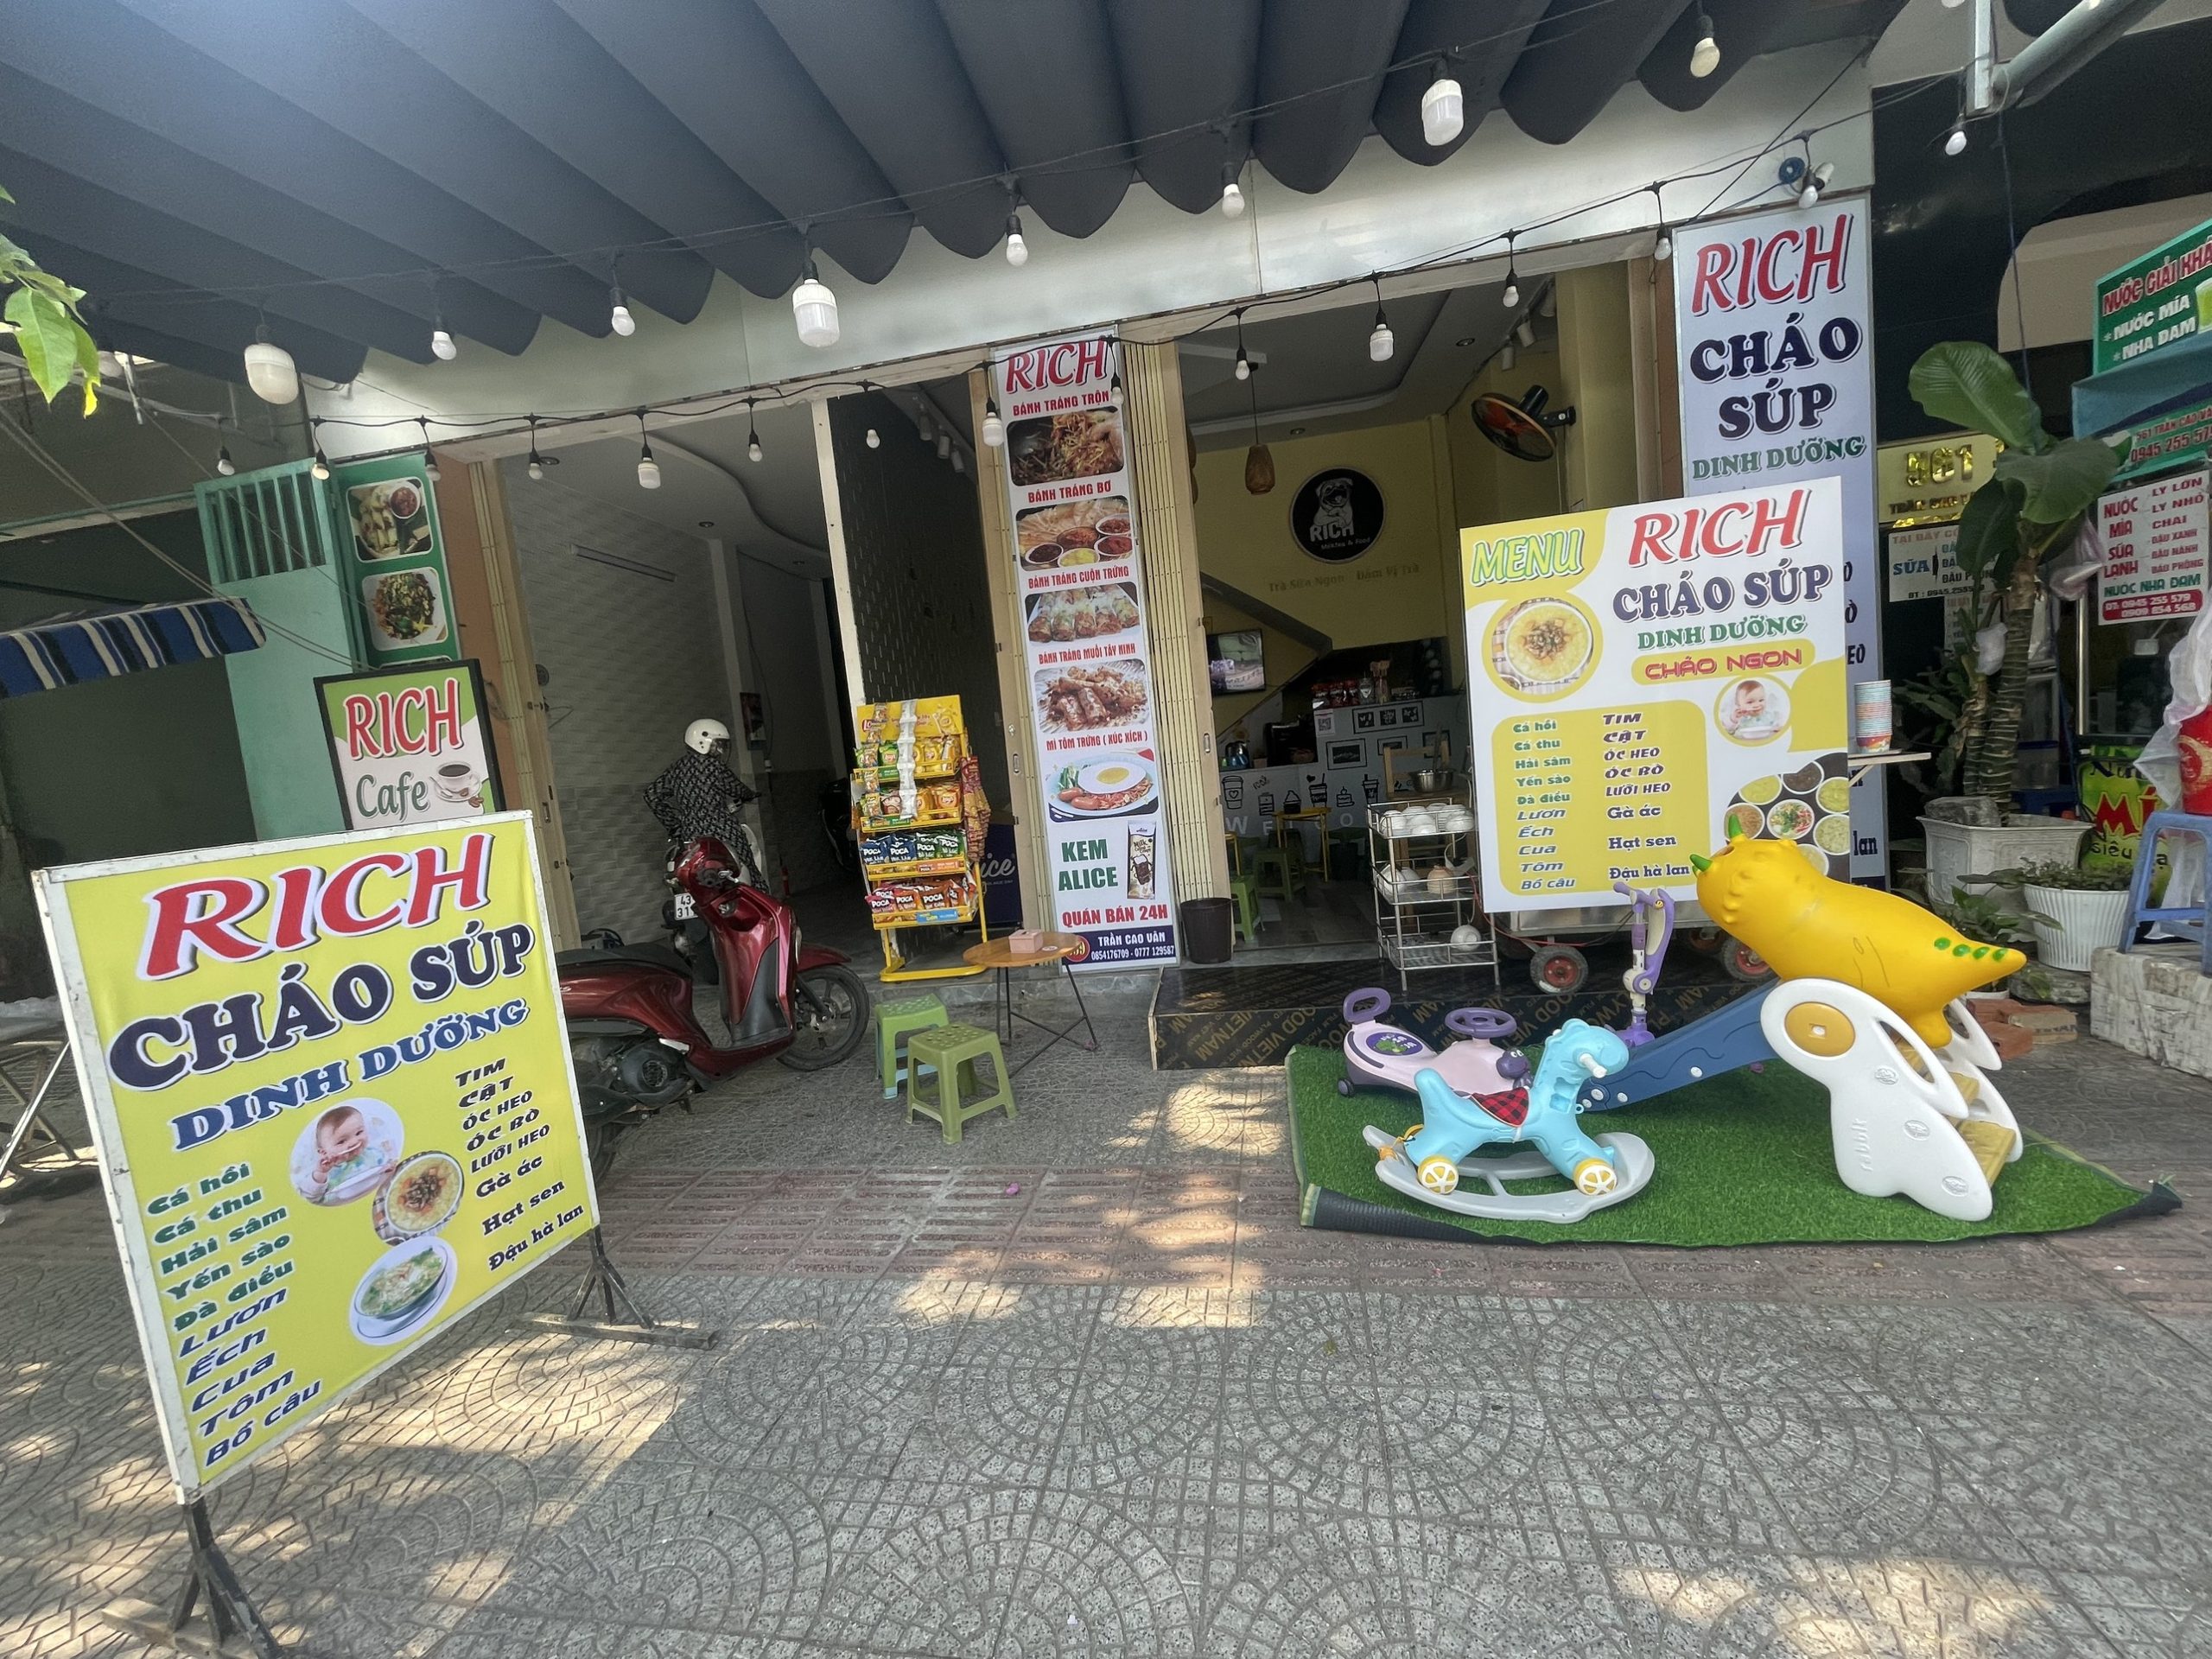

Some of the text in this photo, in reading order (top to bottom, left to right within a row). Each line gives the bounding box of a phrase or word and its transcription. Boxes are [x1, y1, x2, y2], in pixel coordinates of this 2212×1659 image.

[1691, 213, 1853, 316] RICH
[2102, 256, 2178, 316] NƯỚC GIẢI
[2113, 295, 2190, 341] NƯỚC MÍA
[1690, 312, 1863, 383] CHÁO
[2122, 336, 2154, 359] NHA
[1005, 335, 1109, 394] RICH
[1013, 390, 1109, 416] BÁNH TRÁNG TRỘN
[1719, 378, 1836, 440] SÚP
[1693, 435, 1866, 480] DINH DƯỠNG
[2131, 434, 2190, 463] 0945 255
[1028, 487, 1056, 503] BÁNH
[1059, 483, 1093, 499] TRÁNG
[2152, 487, 2166, 497] LY
[2152, 503, 2166, 513] LY
[1309, 523, 1355, 543] RICH
[1628, 488, 1811, 569] RICH
[2152, 514, 2188, 531] CHAI
[1471, 527, 1584, 587] MENU
[1893, 559, 1930, 576] SỮA
[1028, 564, 1129, 588] BÁNH TRÁNG CUỘN TRỨNG
[2140, 574, 2201, 592] NHA ĐAM
[1612, 557, 1834, 624] CHÁO SÚP
[2150, 593, 2191, 606] 255 579
[1637, 613, 1808, 651] DINH DƯỠNG
[1039, 652, 1058, 664] BÁNH
[1058, 648, 1081, 662] TRÁNG
[1118, 642, 1136, 655] NINH
[1726, 648, 1802, 672] NGON
[344, 677, 463, 760] RICH
[1513, 721, 1529, 733] Cá
[1602, 713, 1642, 725] TIM
[1058, 736, 1075, 749] TÔM
[1077, 734, 1101, 747] TRỨNG
[1514, 739, 1560, 751] Cá thu
[1603, 730, 1646, 743] CẬT
[1515, 755, 1571, 770] Hải sâm
[1604, 747, 1661, 760] ÓC HEO
[1516, 773, 1571, 786] Yến sào
[1605, 763, 1664, 778] ÓC BÒ
[355, 770, 429, 822] Cafe
[1605, 782, 1670, 797] LƯỠI HEO
[1516, 807, 1566, 820] Lươn
[1607, 804, 1661, 818] Gà ác
[1517, 824, 1554, 837] Ếch
[890, 847, 909, 855] POCA
[941, 839, 958, 848] POCA
[1061, 838, 1109, 862] KEM
[1518, 844, 1556, 855] Cua
[1608, 836, 1675, 853] Hạt sen
[1853, 830, 1878, 856] lan
[2090, 840, 2133, 860] siêu
[1058, 866, 1119, 892] ALICE
[1520, 861, 1563, 873] Tôm
[1609, 863, 1689, 881] Đậu hà lan
[1547, 877, 1575, 888] câu
[138, 834, 493, 980] RICH
[923, 893, 944, 903] POCA
[1062, 904, 1168, 928] QUÁN BÁN 24H
[1098, 931, 1166, 947] TRẦN CAO VÂN
[1090, 944, 1174, 961] 0854176709 0777 129587
[110, 920, 535, 1090] CHÁO SÚP
[170, 998, 530, 1150] DINH DƯỠNG
[455, 1058, 505, 1087] TIM
[459, 1076, 513, 1108] CẬT
[462, 1090, 532, 1130] ÓC HEO
[467, 1108, 539, 1152] ÓC BÒ
[471, 1124, 550, 1173] LƯỠI HEO
[476, 1156, 542, 1198] Gà ác
[147, 1187, 190, 1214] Cá
[482, 1180, 564, 1236] Hạt sen
[154, 1189, 262, 1243] Cá thu
[160, 1207, 287, 1274] Hải sâm
[489, 1205, 583, 1271] Đậu hà lan
[166, 1235, 290, 1300] Yến sào
[179, 1288, 287, 1358] Lươn
[186, 1328, 266, 1386] Ếch
[192, 1352, 276, 1413] Cua
[200, 1370, 294, 1438] Tôm
[264, 1381, 321, 1427] câu
